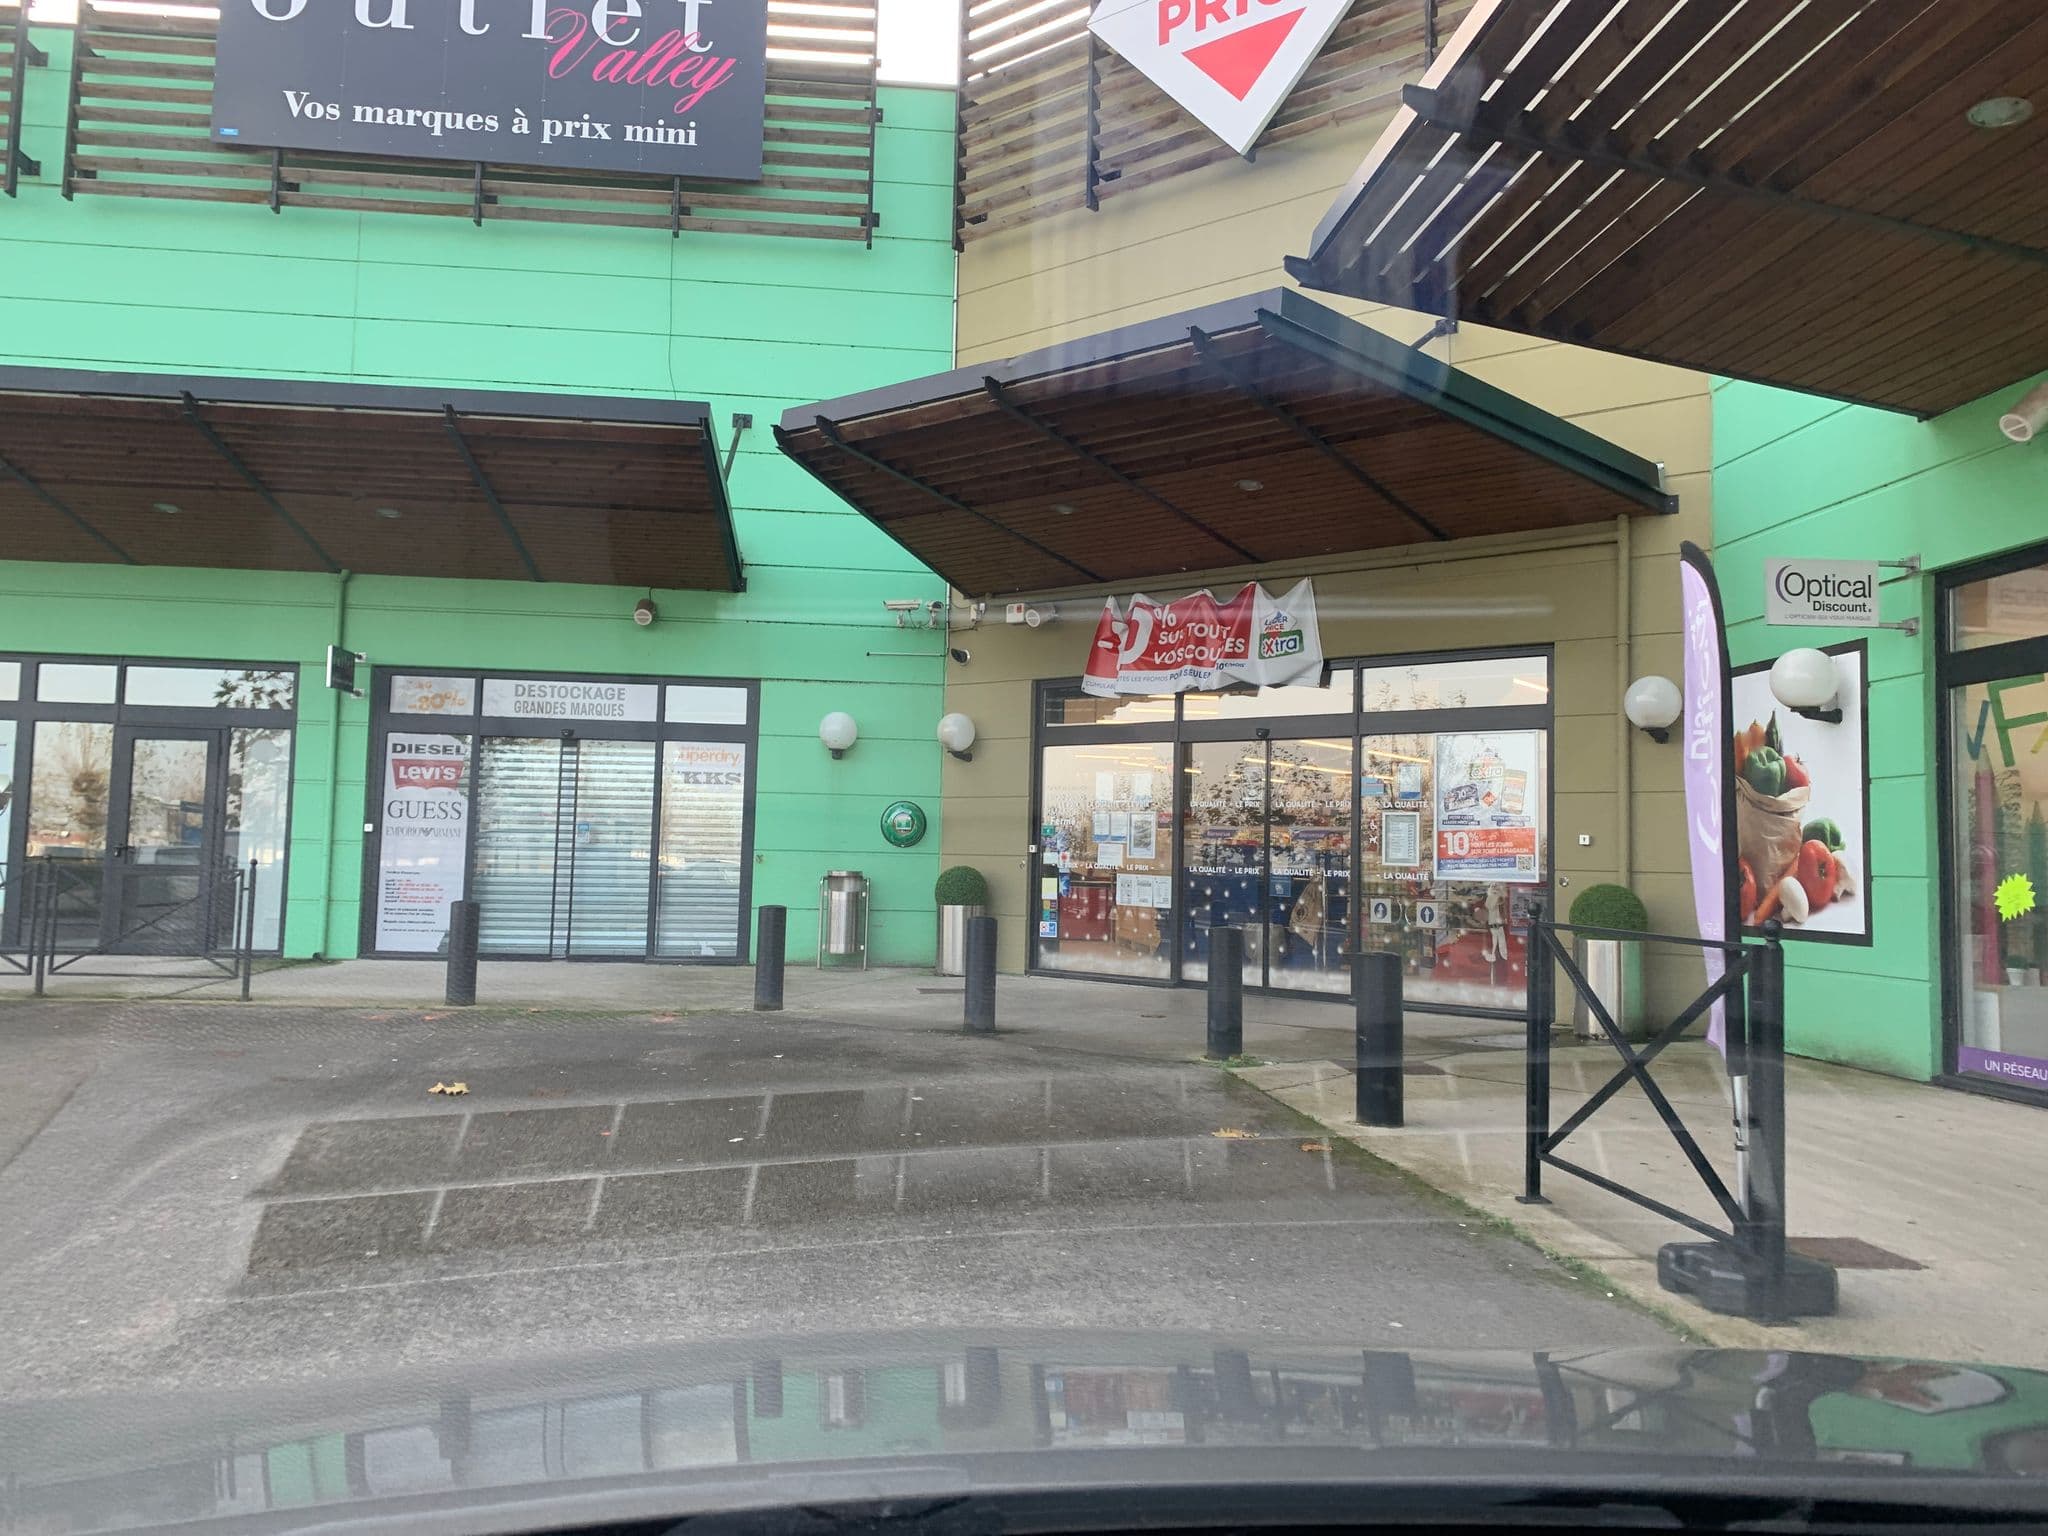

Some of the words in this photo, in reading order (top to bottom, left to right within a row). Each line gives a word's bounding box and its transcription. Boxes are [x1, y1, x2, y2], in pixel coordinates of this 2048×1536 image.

[545, 8, 738, 114] Valley
[283, 90, 341, 121] Vos
[352, 105, 500, 137] marques
[511, 107, 531, 135] à
[540, 113, 612, 145] prix
[623, 119, 698, 146] mini
[1783, 572, 1872, 603] Optical
[514, 683, 627, 701] DESTOCKAGE
[513, 700, 567, 716] GRANDES
[570, 702, 625, 718] MARQUES
[392, 743, 467, 757] DIESEL
[387, 800, 463, 820] GUESS
[1984, 1059, 2001, 1072] UN
